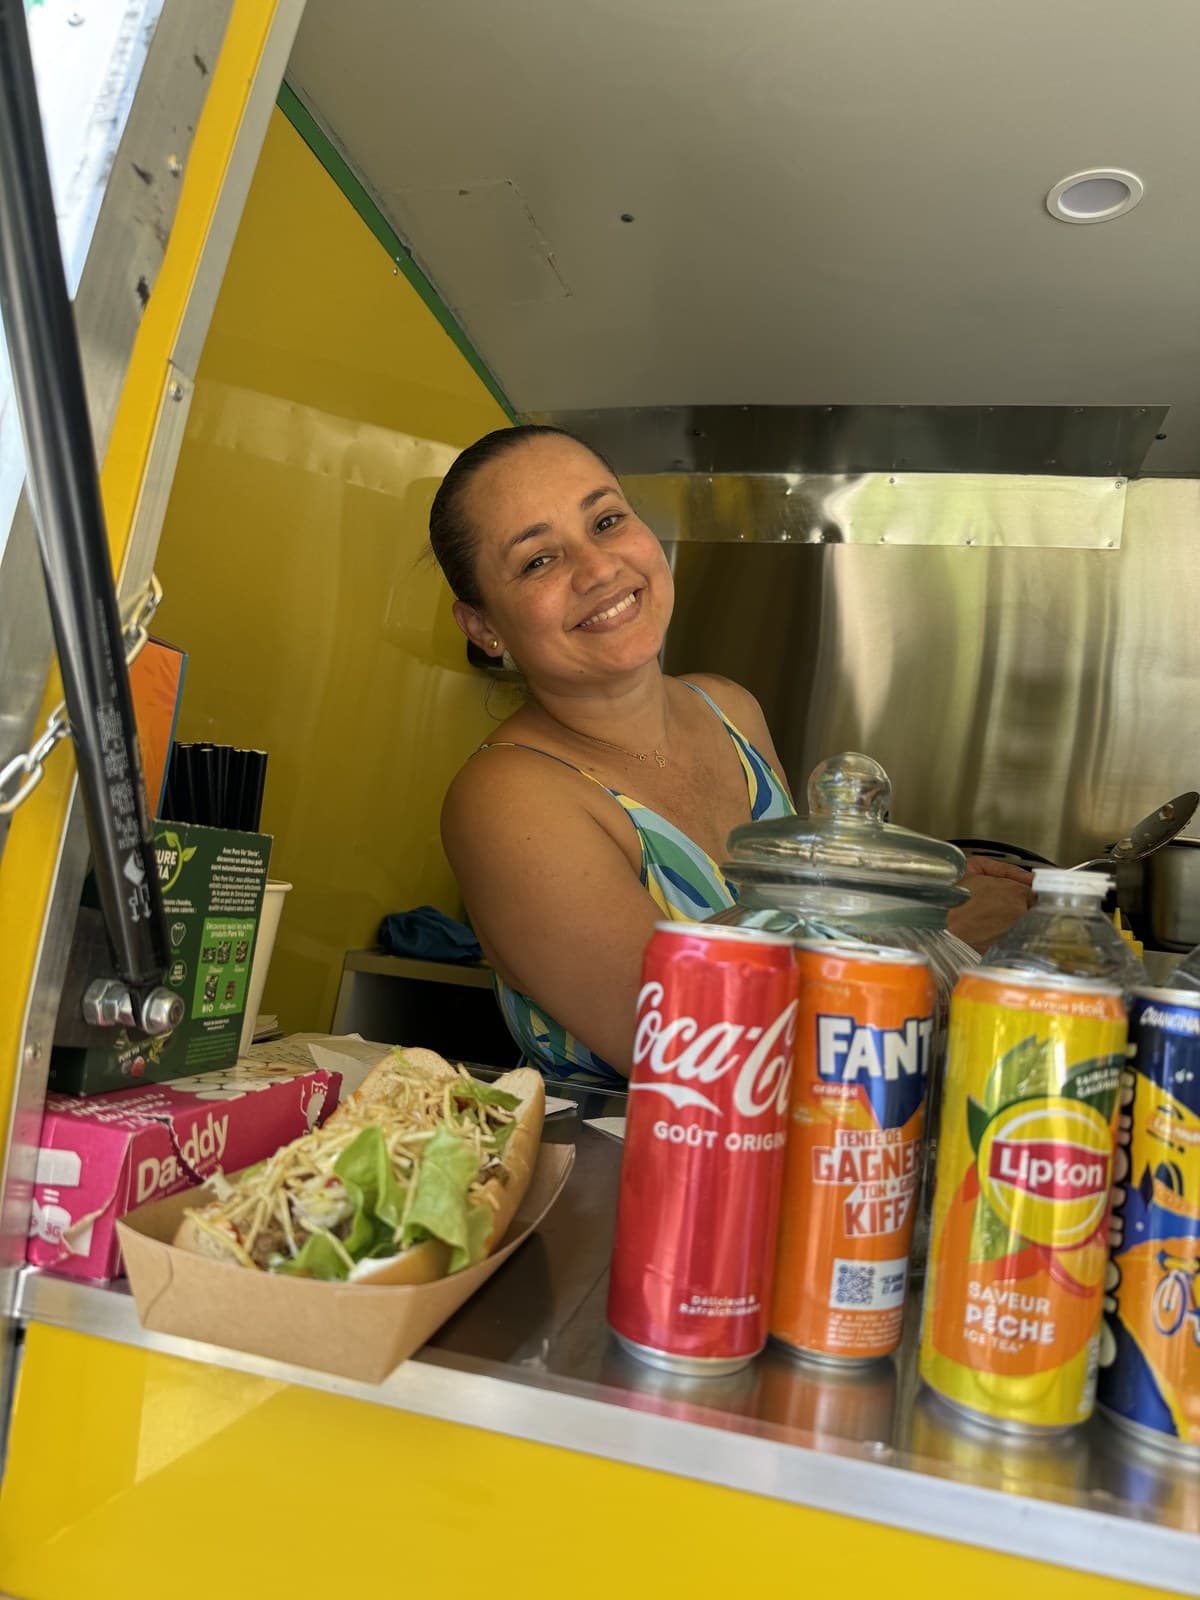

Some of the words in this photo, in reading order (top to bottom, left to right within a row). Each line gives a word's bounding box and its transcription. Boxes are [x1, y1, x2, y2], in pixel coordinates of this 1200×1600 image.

[155, 849, 178, 865] URE
[158, 865, 171, 880] IA
[653, 1120, 719, 1149] GOÛT
[839, 1130, 881, 1147] TENTE
[886, 1129, 901, 1145] DE
[137, 1112, 228, 1204] Daddy
[1000, 1147, 1103, 1188] Lipton
[845, 1196, 905, 1236] KIFF
[968, 1280, 1051, 1315] SAVEUR
[965, 1299, 1056, 1345] PÊCHE
